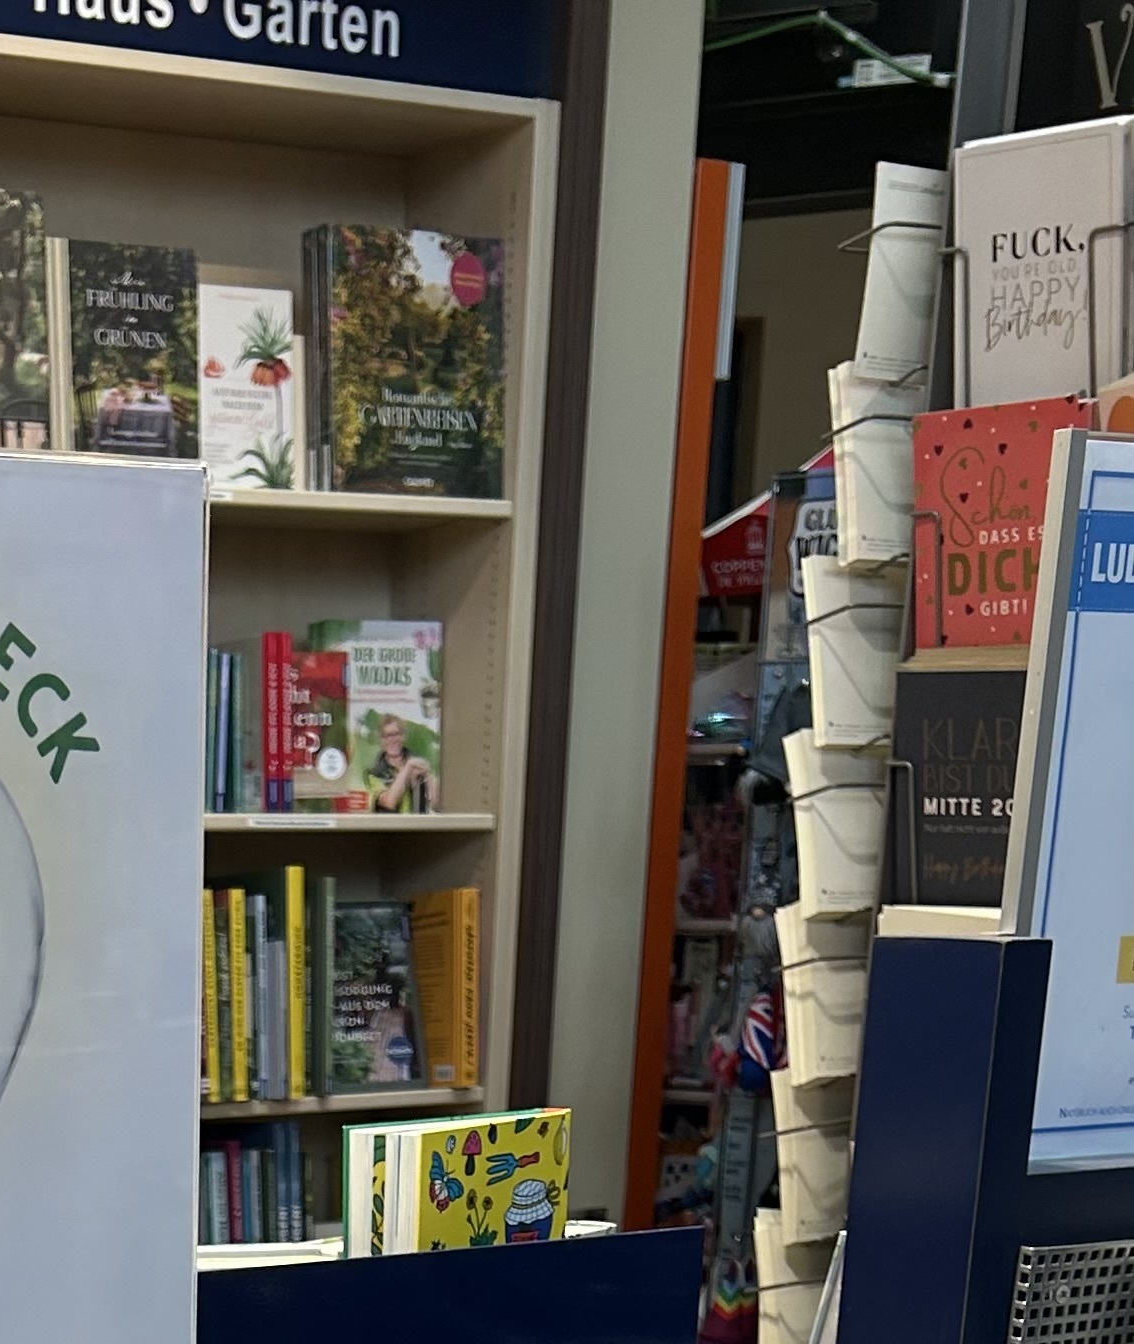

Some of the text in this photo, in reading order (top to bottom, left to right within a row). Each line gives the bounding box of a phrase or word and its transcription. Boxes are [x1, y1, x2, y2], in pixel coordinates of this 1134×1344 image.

[224, 0, 401, 58] Garten
[991, 223, 1088, 263] FUCK,
[85, 286, 175, 313] FRÜHLING
[990, 277, 1084, 311] HAPPY
[978, 528, 1020, 546] DASS
[947, 548, 1040, 597] DICH
[979, 599, 1028, 618] GIBT!
[923, 797, 983, 817] MITTE
